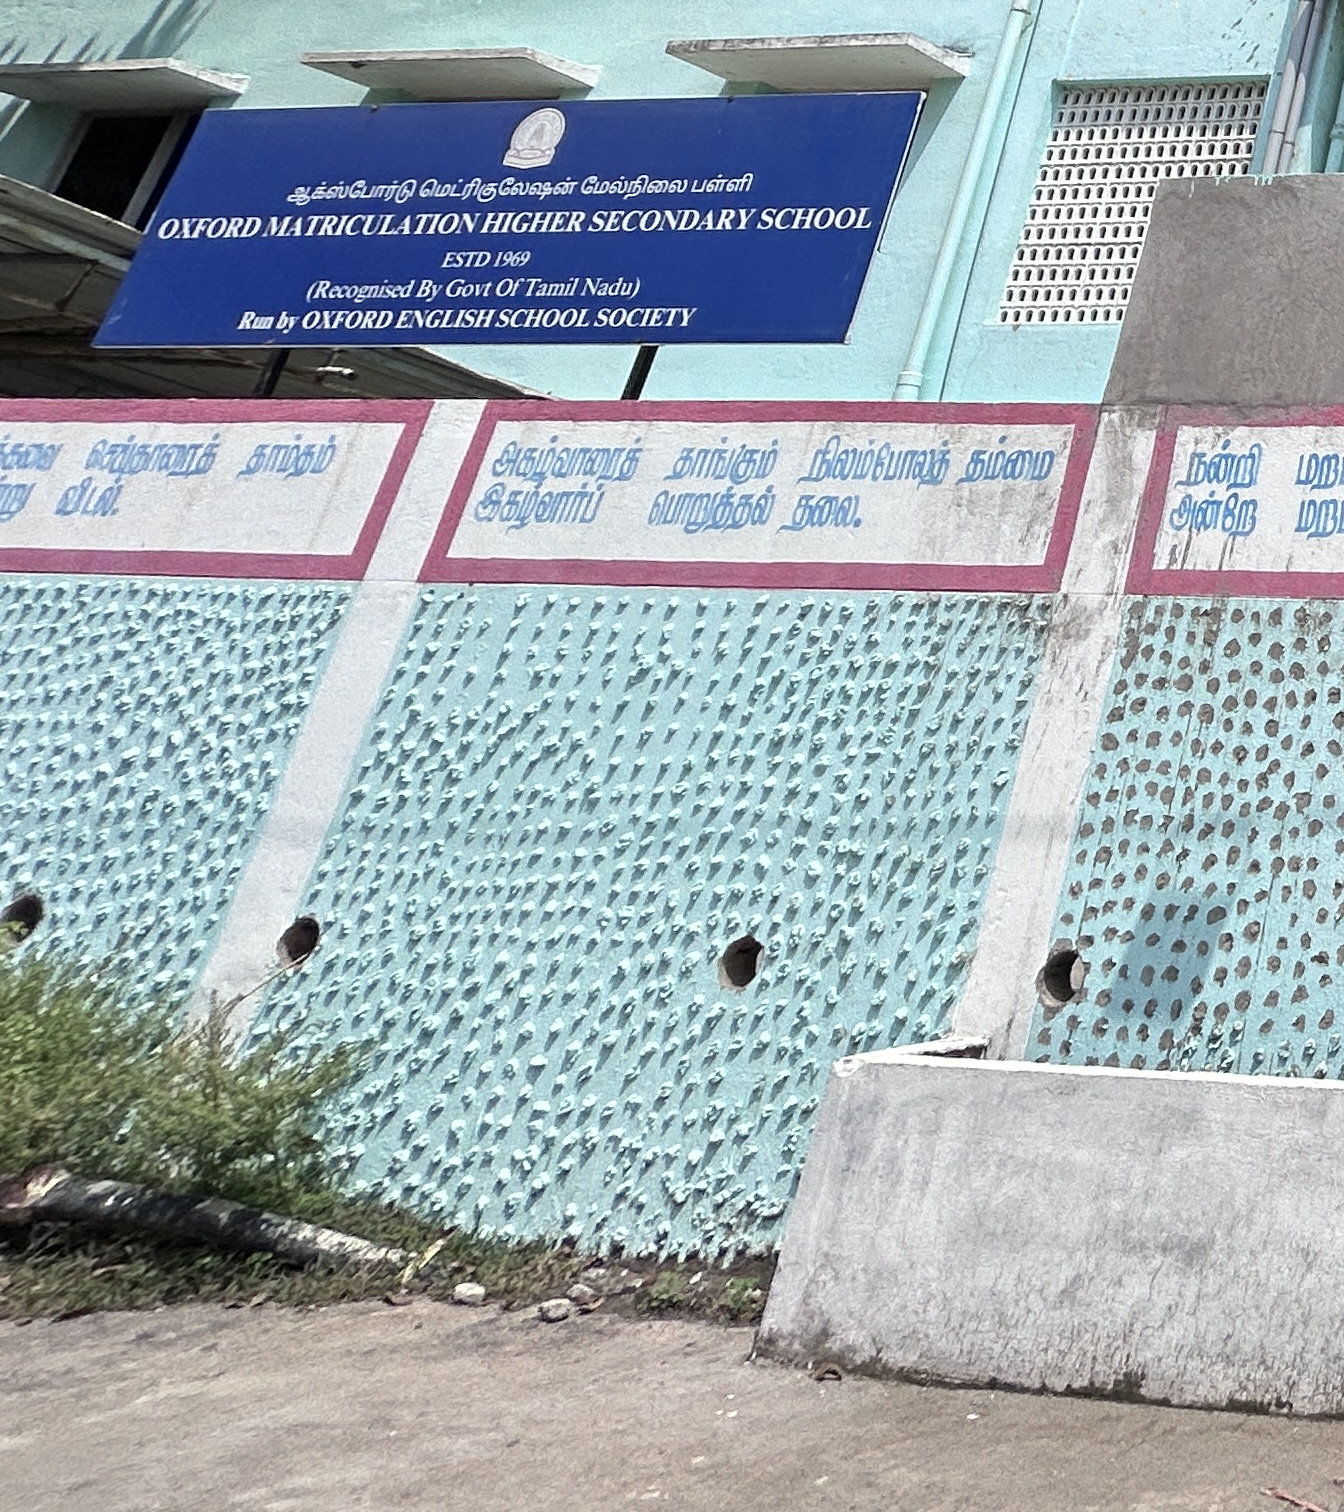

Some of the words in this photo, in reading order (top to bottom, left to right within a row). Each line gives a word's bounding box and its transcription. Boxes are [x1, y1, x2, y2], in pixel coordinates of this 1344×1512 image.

[287, 180, 416, 205] ஆக்ஸ்போர்டு
[419, 177, 578, 202] மெட்ரிகுலேஷன்
[581, 175, 688, 198] மேல்நிலை
[691, 173, 753, 193] பள்ளி
[158, 217, 263, 239] OXFORD
[263, 213, 481, 237] MATRICULATION
[482, 212, 583, 233] HIGHER
[590, 209, 756, 231] SECONDARY
[755, 208, 872, 229] SCHOOL
[442, 252, 491, 268] ESTD
[494, 251, 531, 267] 1969
[307, 280, 415, 303] (Recognised
[416, 280, 442, 303] By
[446, 279, 492, 297] Govt
[496, 278, 525, 297] Of
[525, 278, 579, 296] Tamil
[582, 278, 641, 299] Nadu)
[237, 312, 273, 330] Run
[274, 312, 300, 334] by
[302, 311, 396, 330] OXFORD
[396, 309, 498, 329] ENGLISH
[498, 309, 590, 328] SCHOOL
[594, 308, 697, 327] SOCIETY
[663, 436, 780, 484] தாங்கும்
[955, 435, 1056, 485] தம்மை
[1173, 439, 1264, 491] நன்றி
[648, 485, 777, 533] பொறுத்தல்
[1169, 490, 1259, 537] அன்றே
